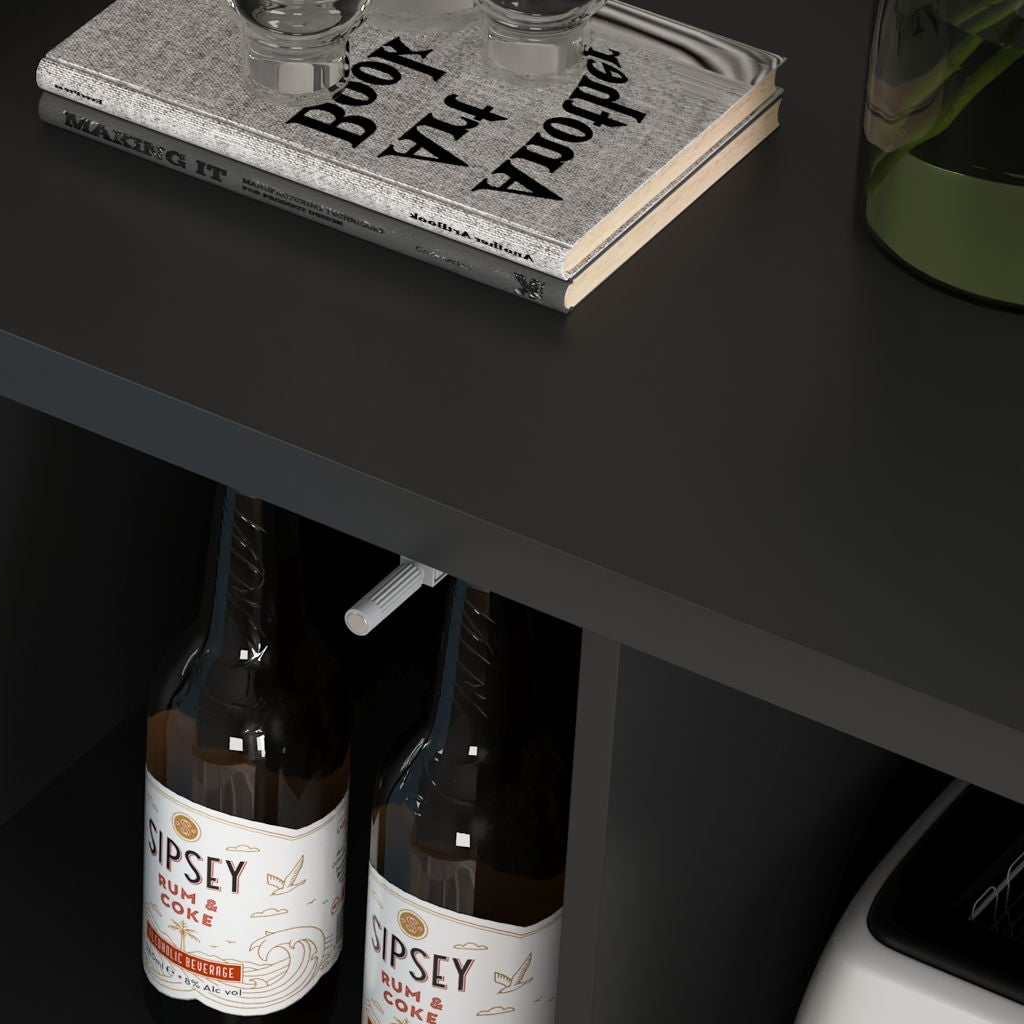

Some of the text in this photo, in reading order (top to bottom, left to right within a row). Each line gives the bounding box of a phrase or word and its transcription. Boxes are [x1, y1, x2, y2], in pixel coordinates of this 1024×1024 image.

[195, 159, 228, 183] IT
[148, 818, 248, 894] SIPSEY
[158, 872, 219, 913] RUM &
[160, 893, 214, 928] COKE
[185, 956, 235, 979] BEVERAGE
[371, 914, 476, 992] SIPSEY
[184, 977, 201, 990] 8%
[204, 984, 221, 994] Alc
[381, 969, 444, 1011] RUM &
